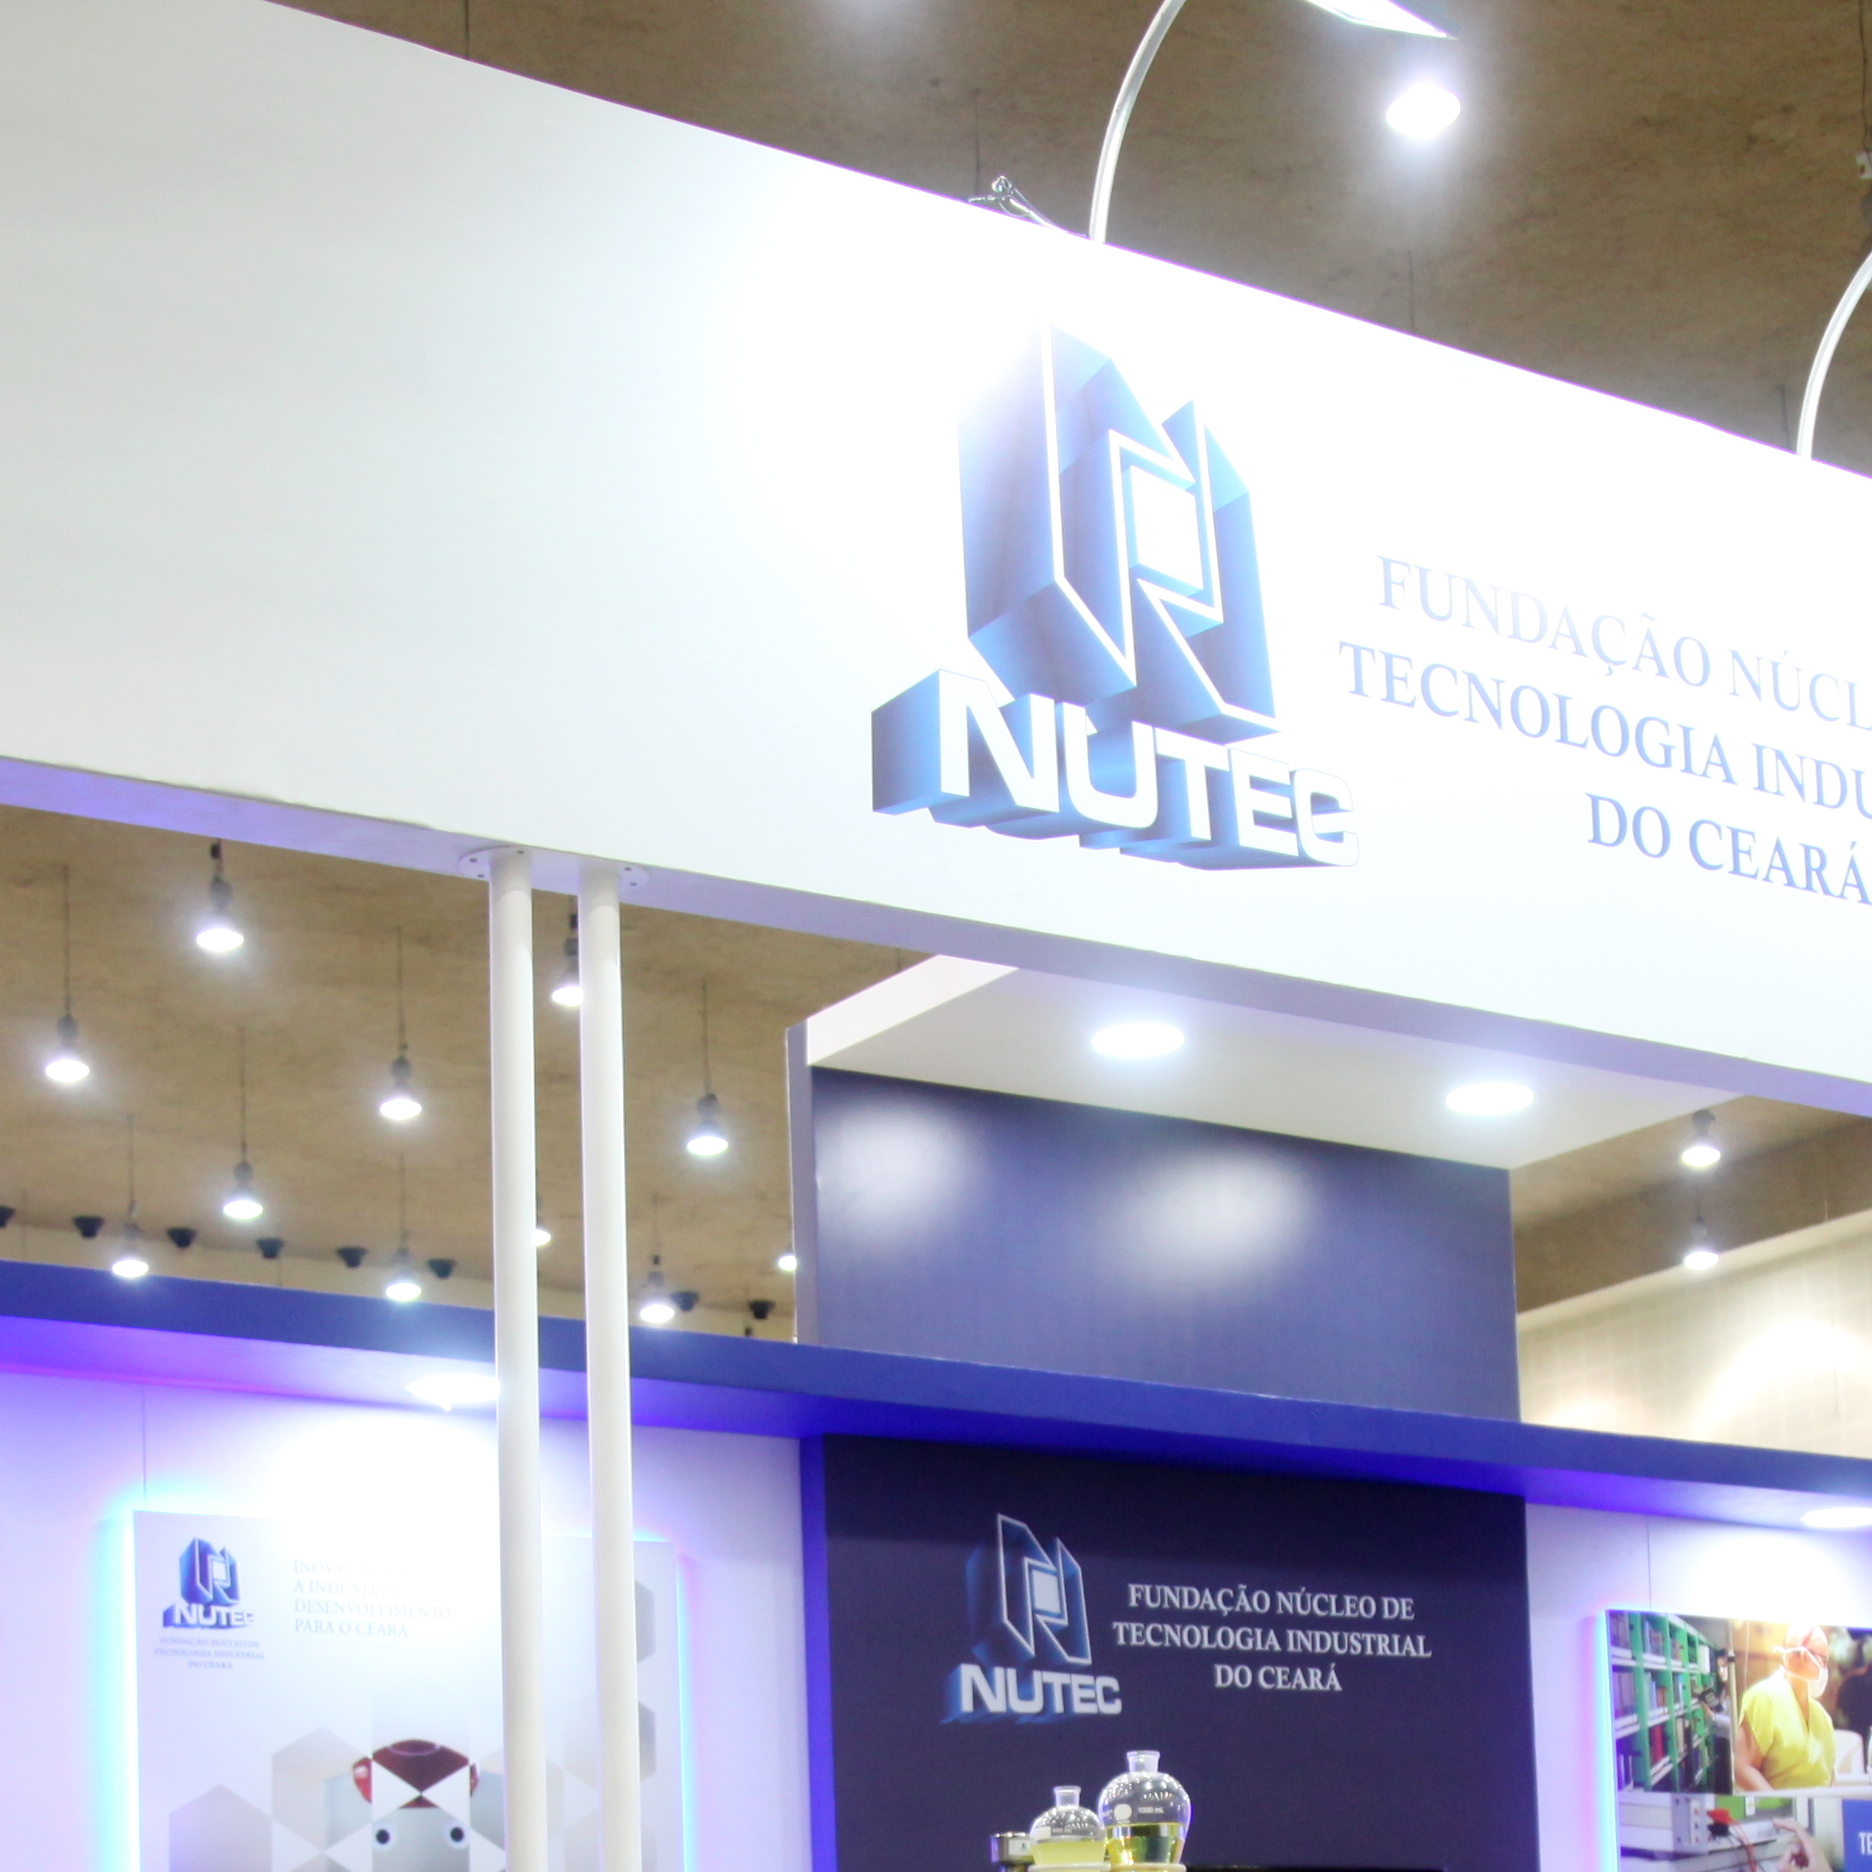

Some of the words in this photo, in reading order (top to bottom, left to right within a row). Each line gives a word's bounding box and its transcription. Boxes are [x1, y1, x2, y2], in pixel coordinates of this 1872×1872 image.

[1377, 555, 1712, 688] FUNDAÇÃO
[1338, 641, 1738, 786] TECNOLOGIA
[936, 667, 1361, 869] NUTEC
[1585, 793, 1671, 858] DO
[294, 1598, 452, 1620] DESENVOLVIMENTO
[1128, 1584, 1270, 1616] FUNDAÇÃO
[1276, 1587, 1376, 1620] NÚCLEO
[1382, 1597, 1416, 1620] DE
[294, 1618, 335, 1634] PARA
[339, 1620, 353, 1635] O
[355, 1620, 409, 1637] CEARÁ
[1113, 1622, 1282, 1652] TECNOLOGIA
[1286, 1628, 1432, 1658] INDUSTRIAL
[960, 1662, 1123, 1715] NUTEC
[1214, 1664, 1252, 1688] DO
[1257, 1663, 1343, 1691] CEARÁ
